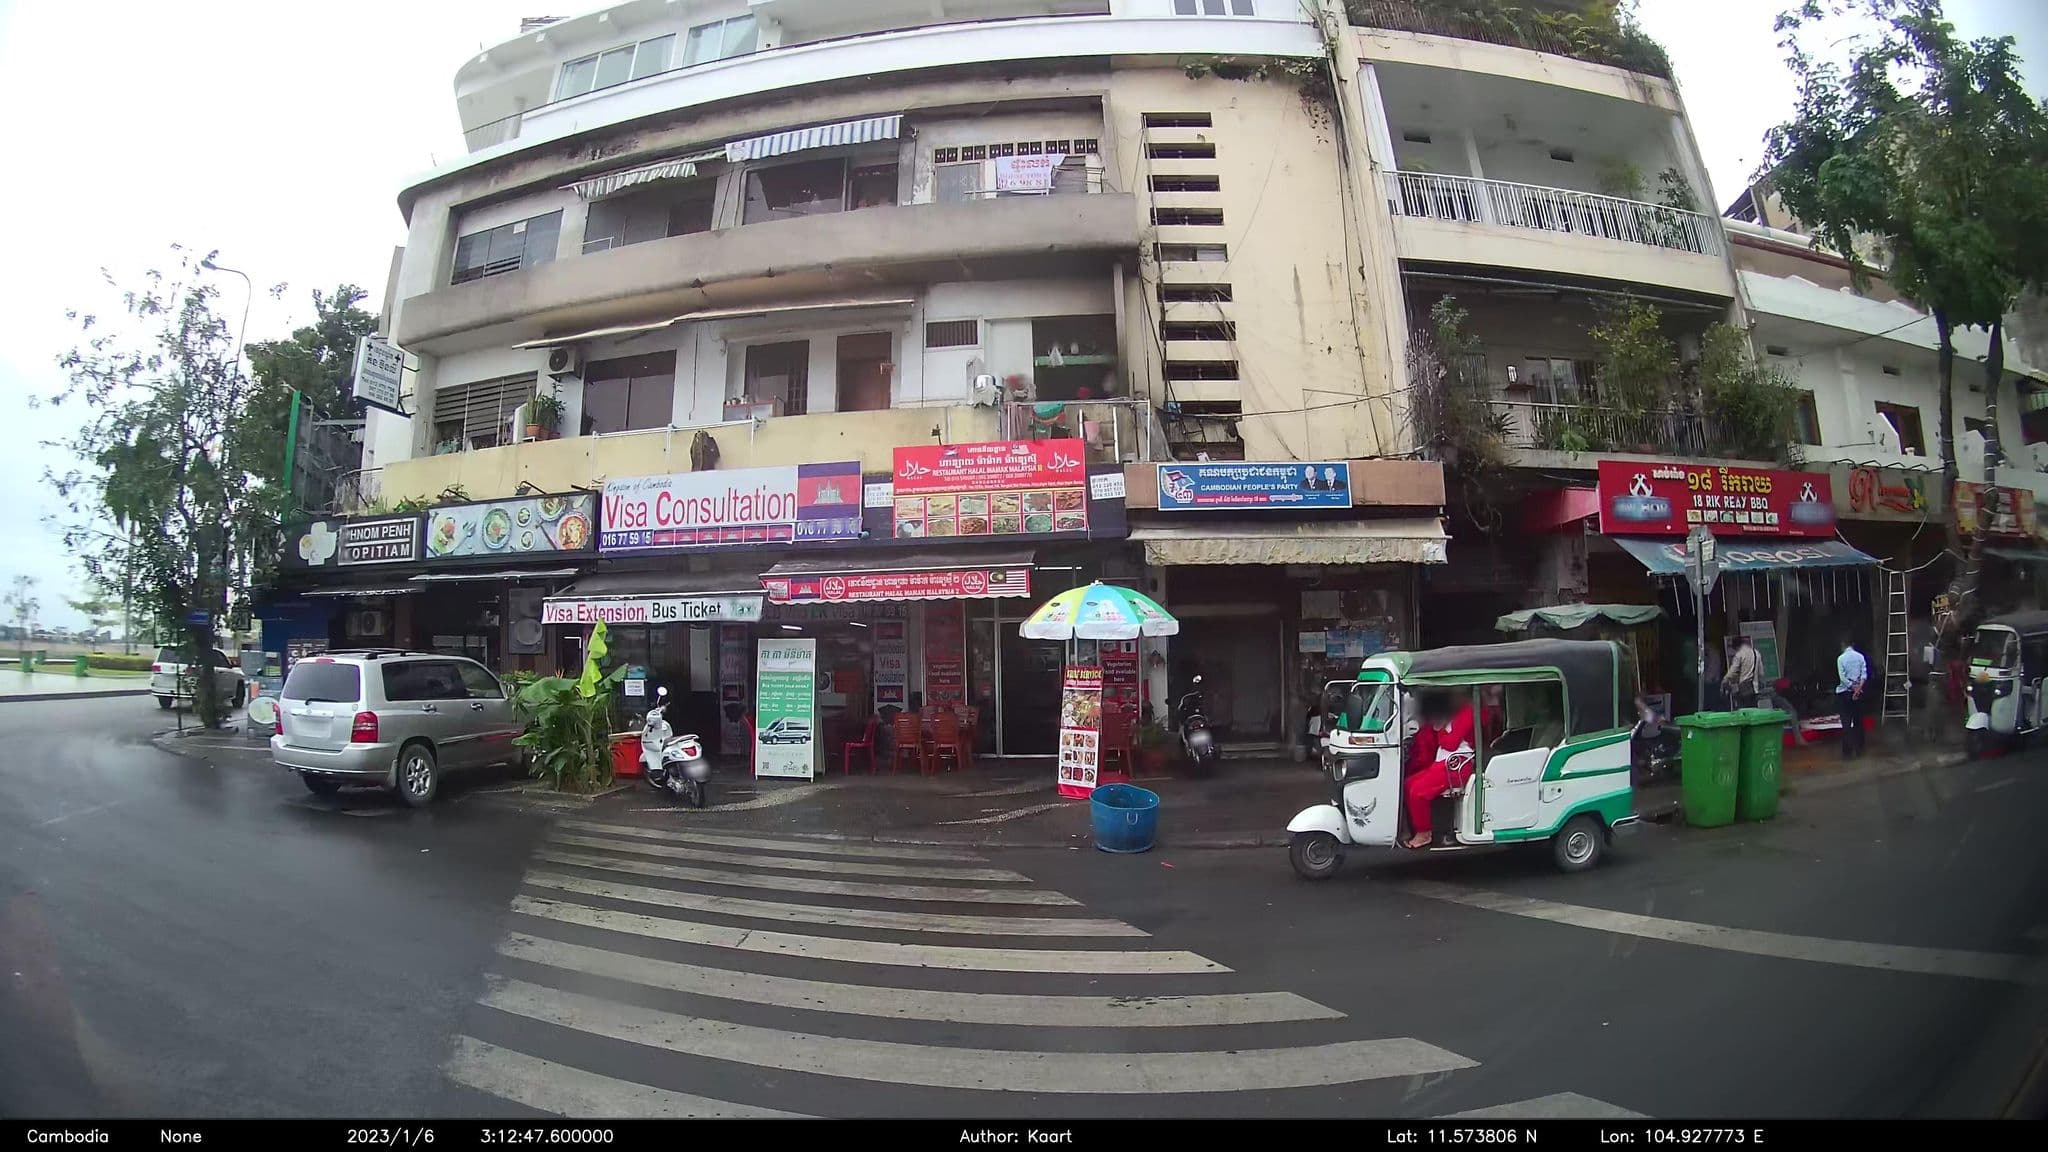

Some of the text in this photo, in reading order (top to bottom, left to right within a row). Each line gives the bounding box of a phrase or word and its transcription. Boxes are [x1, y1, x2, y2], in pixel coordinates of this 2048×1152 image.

[605, 485, 796, 529] Visa Consultation
[1693, 495, 1768, 510] 18 RIK REAY BBQ
[382, 524, 411, 538] PENH
[603, 534, 616, 546] 016
[617, 533, 627, 545] 77
[629, 533, 639, 544] 59
[546, 605, 573, 621] Visa
[652, 602, 677, 619] Bus
[681, 601, 721, 618] Ticket
